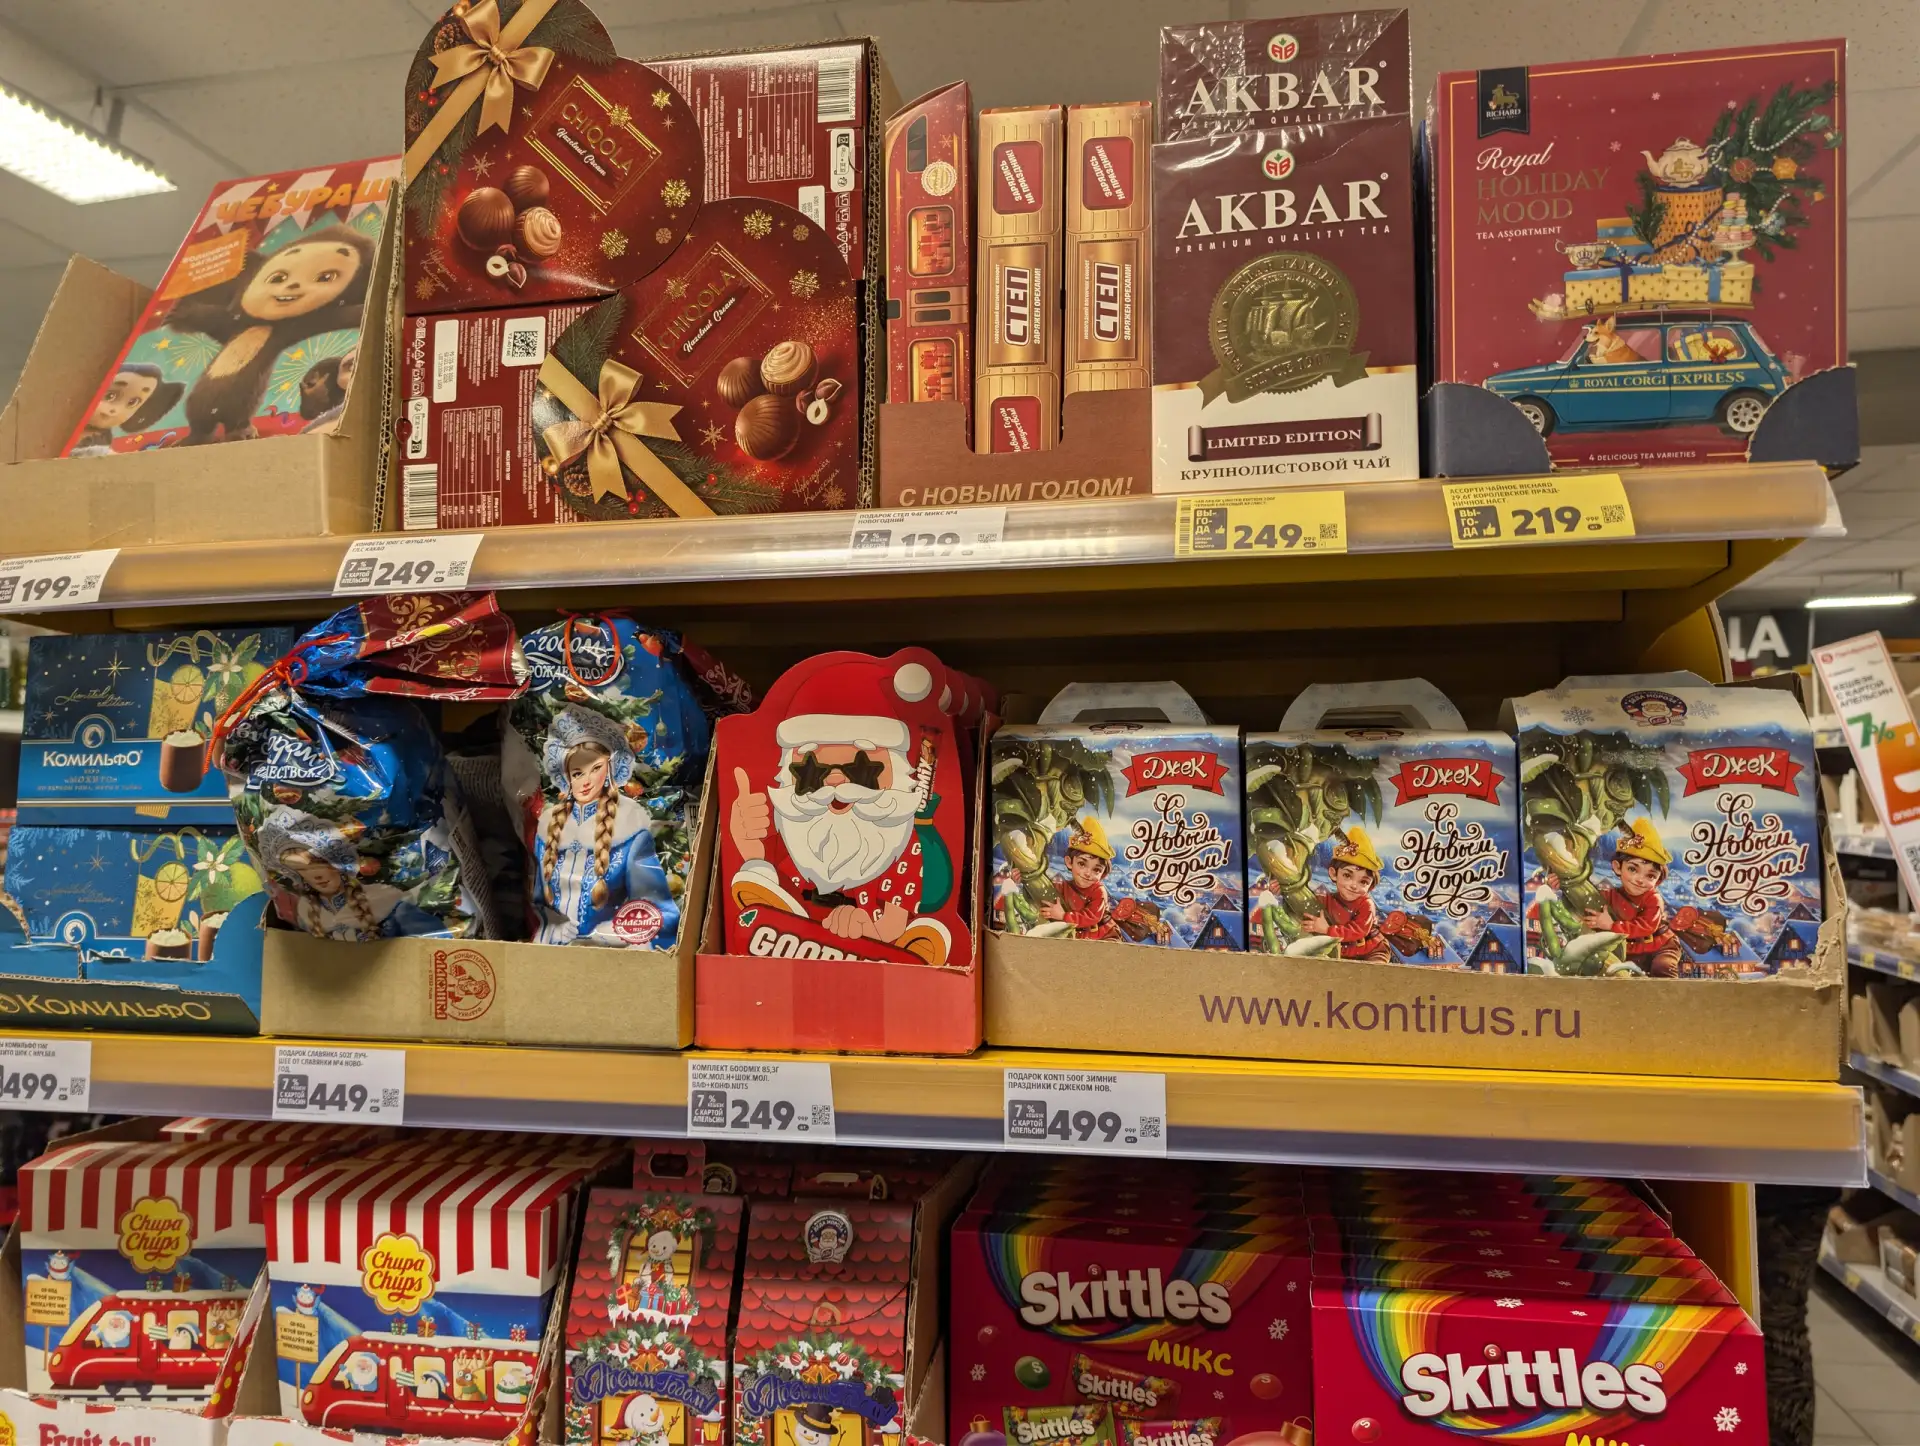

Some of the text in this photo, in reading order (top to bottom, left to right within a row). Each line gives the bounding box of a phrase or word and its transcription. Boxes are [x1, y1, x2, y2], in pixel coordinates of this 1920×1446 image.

[1183, 67, 1386, 116] AKBAR
[1182, 111, 1387, 130] PREMIUM QUALITY TEA
[1486, 109, 1521, 118] RICHARD
[556, 127, 606, 176] Hazelnut Cream
[561, 103, 634, 176] CHIQOLA
[1095, 145, 1126, 200] НА ПРАЗДНИК!
[1476, 142, 1555, 176] Royal
[1000, 160, 1023, 202] ЗАРЯДИСЬ
[1005, 150, 1035, 204] НА ПРАЗДНИК!
[1089, 155, 1113, 198] ЗАРЯДИСЬ
[1478, 166, 1611, 199] HOLIDAY
[1175, 178, 1388, 240] AKBAR
[1478, 198, 1573, 225] MOOD
[1175, 225, 1391, 254] PREMIUM QUALITY TEA
[1476, 226, 1562, 240] TEA ASSORTMENT
[658, 269, 736, 349] CHIQOLA
[1006, 268, 1028, 344] СТЕП
[1034, 268, 1042, 344] ЗАРЯЖЕН ОРЕХАМИ!
[1096, 264, 1118, 339] СТЕП
[1124, 264, 1132, 340] ЗАРЯЖЕН ОРЕХАМИ!
[683, 297, 736, 353] Hazelnut Cream
[1584, 371, 1745, 388] ROYAL CORGI EXPRESS
[1207, 428, 1362, 450] LIMITED EDITION
[1180, 455, 1391, 481] КРУПНОЛИСТОВОЙ ЧАЙ
[1597, 453, 1638, 461] DELICIOUS
[899, 476, 1134, 507] С НОВЫМ ГОДОМ!
[1473, 490, 1530, 498] КОРОЛЕВСКОЕ
[1459, 510, 1481, 518] ВЫ-
[1512, 506, 1581, 537] 219
[861, 534, 868, 543] 7
[901, 532, 960, 557] 129
[1195, 525, 1210, 535] ДА
[1234, 524, 1302, 549] 249
[1462, 528, 1478, 538] ДА
[350, 562, 356, 571] 7
[374, 560, 435, 586] 249
[22, 576, 71, 602] 199
[1846, 711, 1896, 749] 7%
[43, 750, 141, 767] КОМИЛЬФО
[1142, 754, 1209, 781] Джек
[1702, 750, 1780, 780] Джек
[1411, 763, 1484, 789] Джек
[1154, 792, 1191, 827] С
[1424, 801, 1458, 837] С
[1715, 791, 1754, 827] С
[1125, 812, 1222, 862] Новым
[1394, 823, 1499, 872] Новым
[1684, 814, 1795, 866] Новым
[1134, 840, 1233, 907] Годом!
[1403, 850, 1508, 918] Годом!
[1694, 844, 1808, 916] Годом!
[455, 953, 491, 976] КОНДИТЕРСКАЯ
[16, 994, 212, 1020] КОМИЛЬФО
[1199, 991, 1582, 1038] www.kontirus.ru
[692, 1064, 728, 1072] КОМПЛЕКТ
[1008, 1072, 1042, 1080] ПОДАРОК
[1066, 1074, 1084, 1082] 500Г
[1086, 1075, 1117, 1083] ЗИМНИЕ
[3, 1072, 57, 1100] 499
[282, 1078, 289, 1090] 7
[309, 1083, 368, 1112] 449
[1009, 1082, 1052, 1090] ПРАЗДНИКИ
[1059, 1084, 1093, 1092] ДЖЕКОМ
[697, 1095, 704, 1107] 7
[731, 1099, 795, 1130] 249
[1015, 1104, 1035, 1118] 7 %
[1011, 1127, 1045, 1135] АПЕЛЬСИН
[1018, 1119, 1043, 1127] КАРТОЙ
[1048, 1110, 1121, 1142] 499
[129, 1213, 183, 1239] Chupa
[125, 1233, 181, 1262] Chups
[371, 1251, 425, 1277] Chupa
[368, 1270, 423, 1302] Chups
[1019, 1268, 1233, 1326] Skittles
[1147, 1338, 1234, 1377] МИКС
[590, 1363, 655, 1394] Новым
[1077, 1373, 1158, 1408] Skittles
[1401, 1347, 1668, 1418] Skittles
[1016, 1416, 1095, 1444] Skittles
